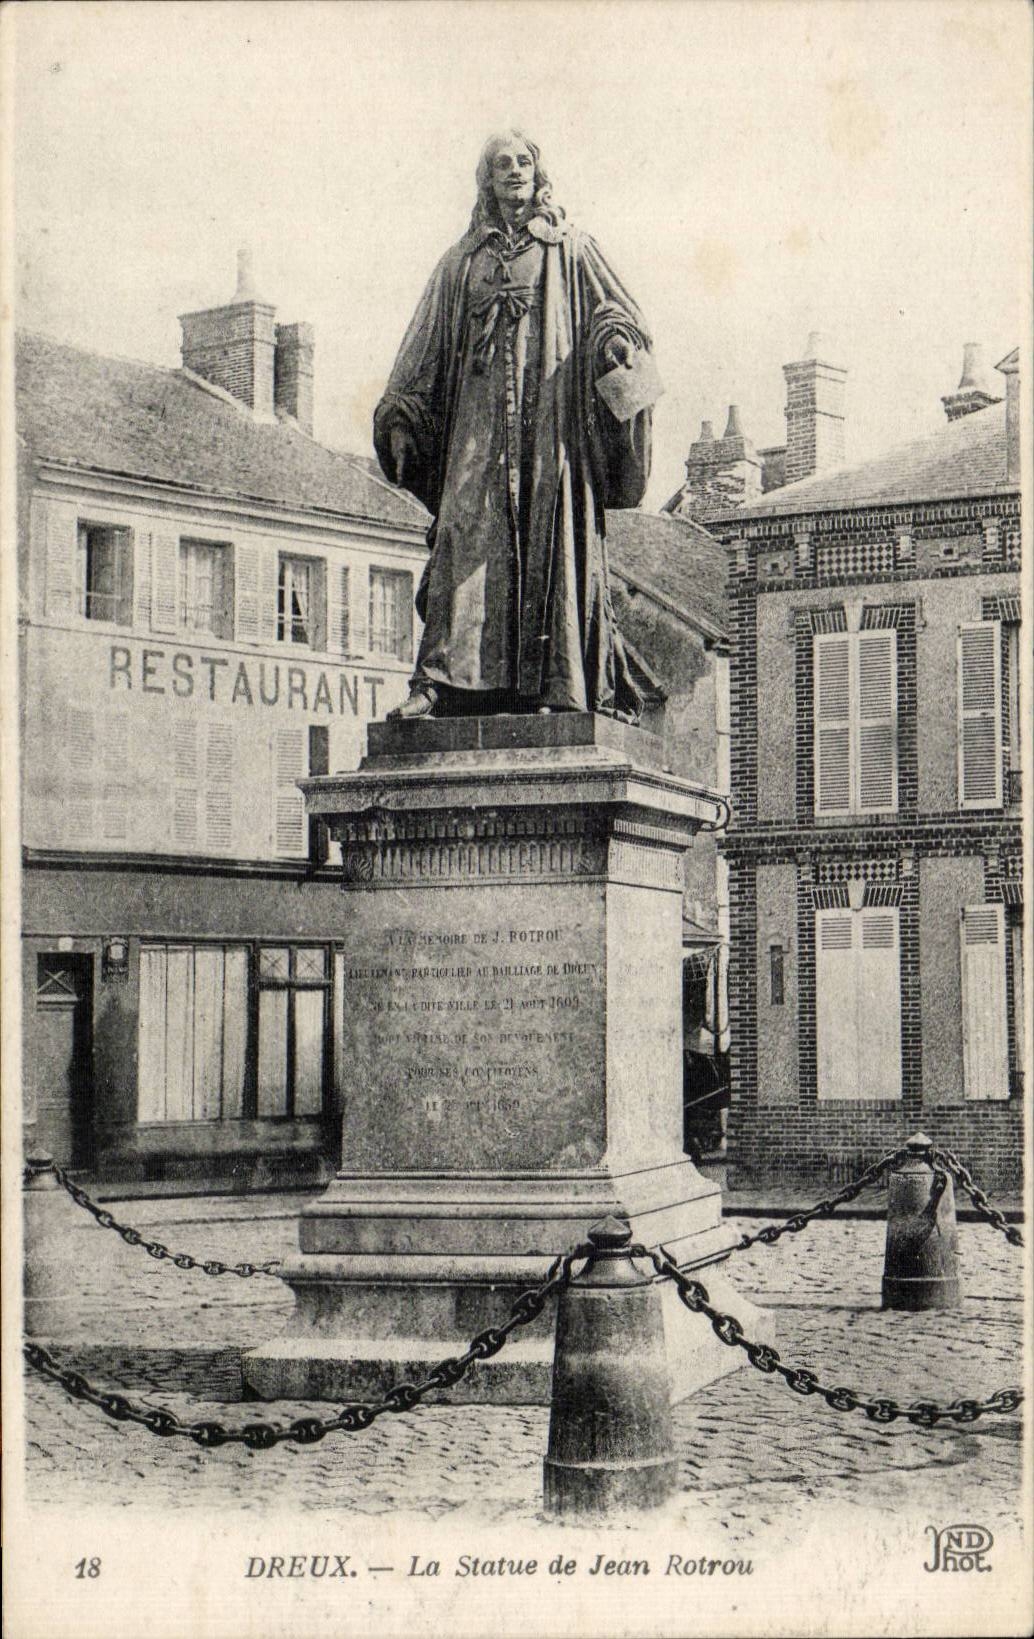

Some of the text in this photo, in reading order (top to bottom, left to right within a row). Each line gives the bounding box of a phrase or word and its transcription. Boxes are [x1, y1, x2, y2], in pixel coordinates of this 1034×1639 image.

[109, 646, 386, 719] RESTAURANT
[473, 933, 488, 944] DE
[509, 929, 562, 943] ROTROU
